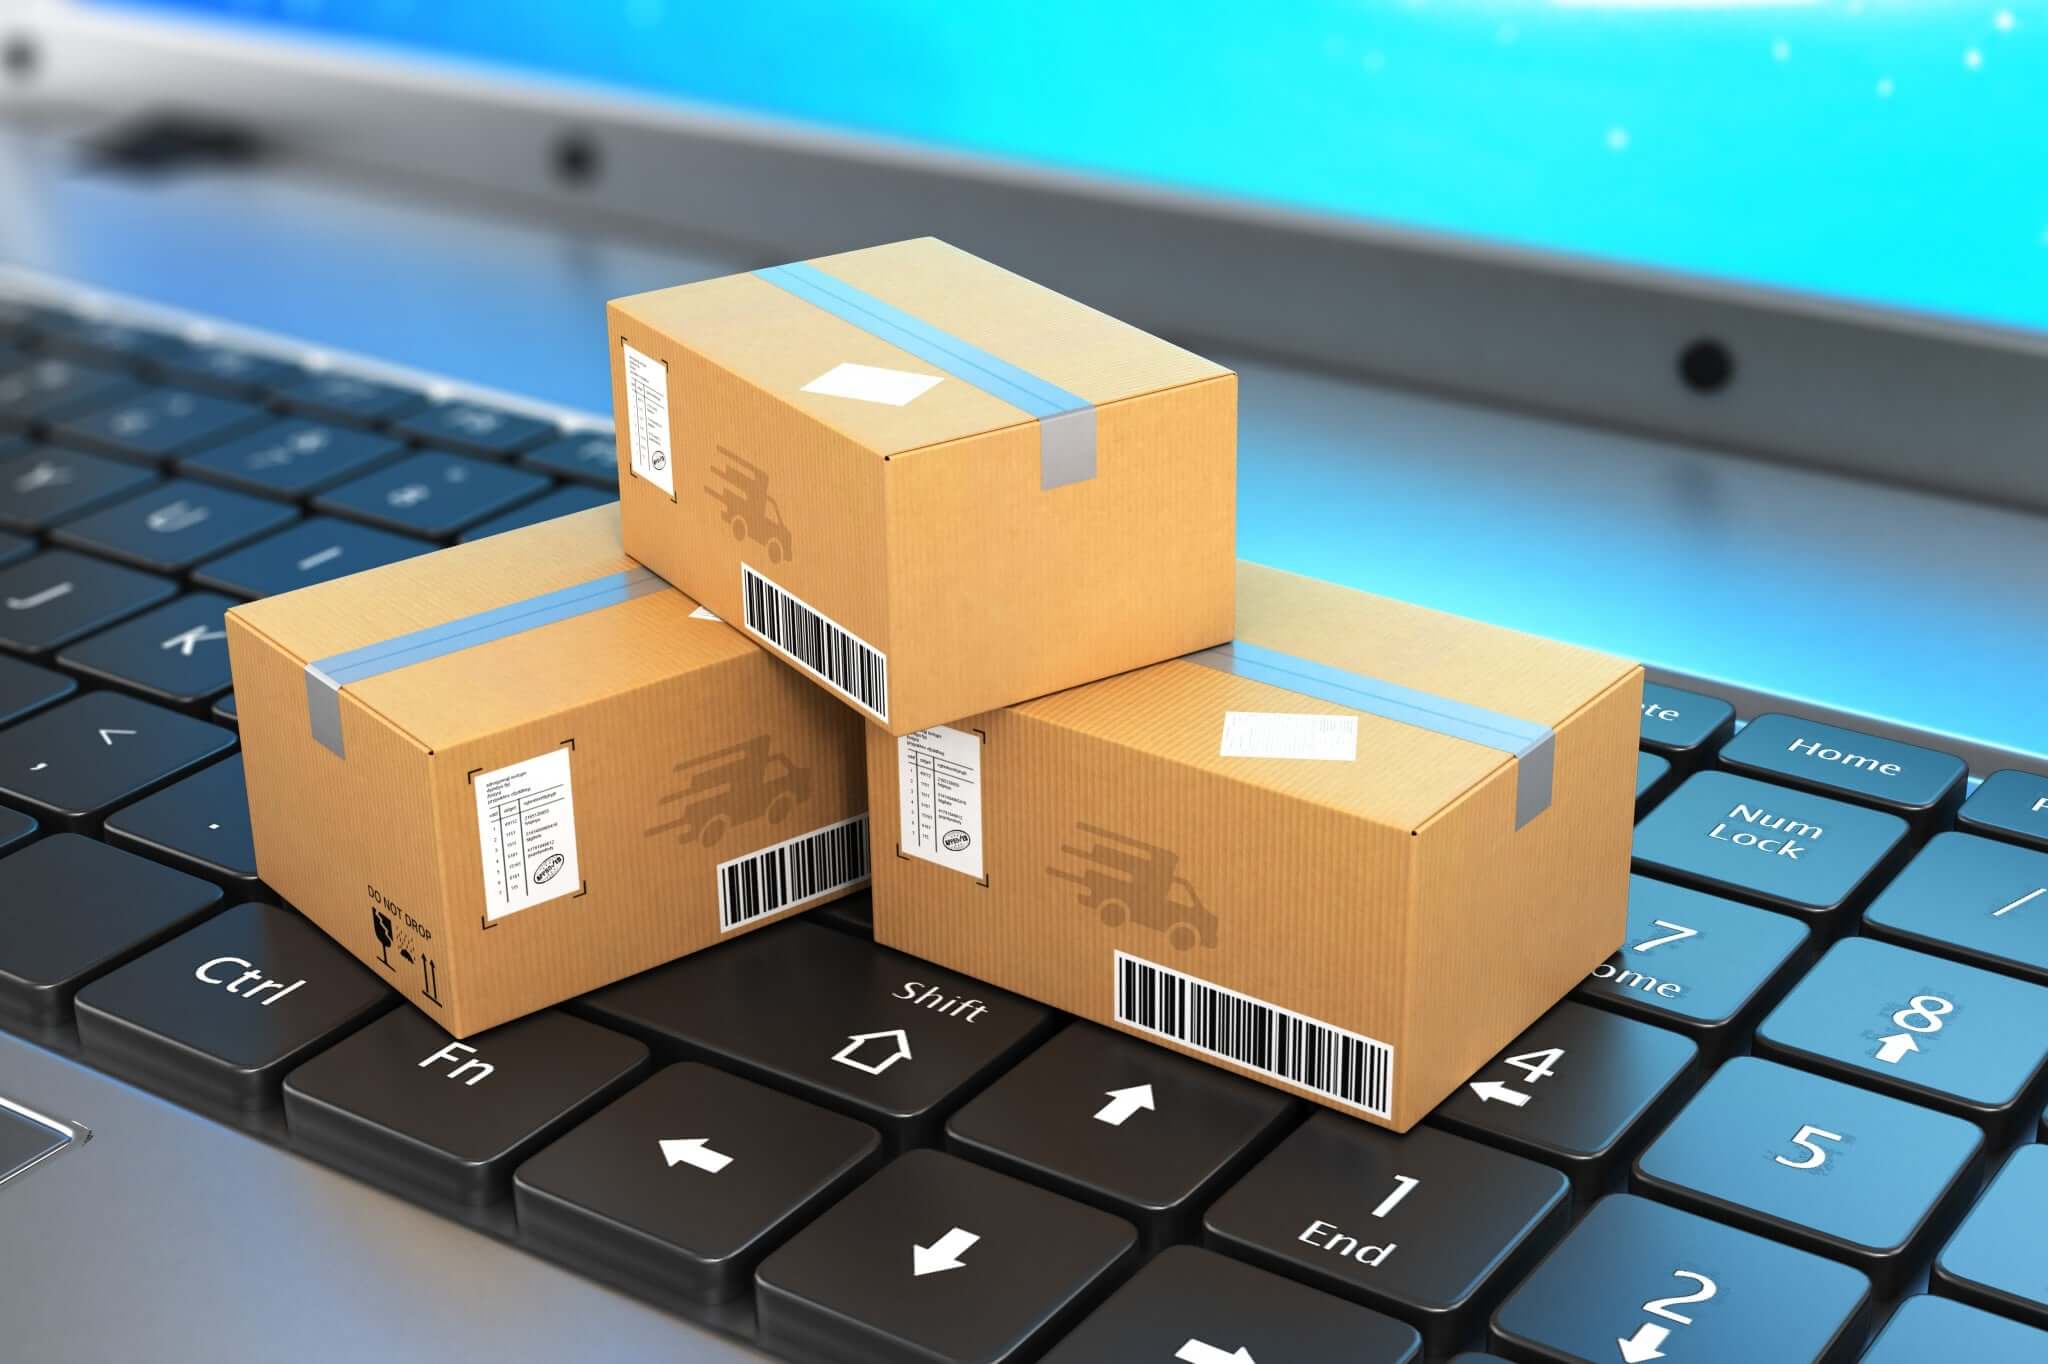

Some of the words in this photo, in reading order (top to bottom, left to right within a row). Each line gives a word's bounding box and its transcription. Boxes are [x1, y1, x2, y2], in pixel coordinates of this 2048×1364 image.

[7, 580, 74, 610] J
[160, 624, 227, 656] K
[1786, 737, 1902, 776] Home
[1708, 823, 1806, 860] Lock
[1728, 803, 1824, 839] Num
[367, 884, 382, 903] DO
[383, 897, 402, 920] NOT
[404, 913, 432, 941] DROP
[1632, 919, 1699, 952] 7
[194, 956, 306, 1006] Ctrl
[891, 981, 989, 1024] Shift
[1892, 995, 1954, 1033] 8
[417, 1041, 495, 1087] Fn
[1503, 1047, 1566, 1084] 4
[1774, 1124, 1843, 1169] 5
[1371, 1173, 1421, 1219] 1
[1297, 1219, 1399, 1268] End
[1641, 1269, 1718, 1326] 2
